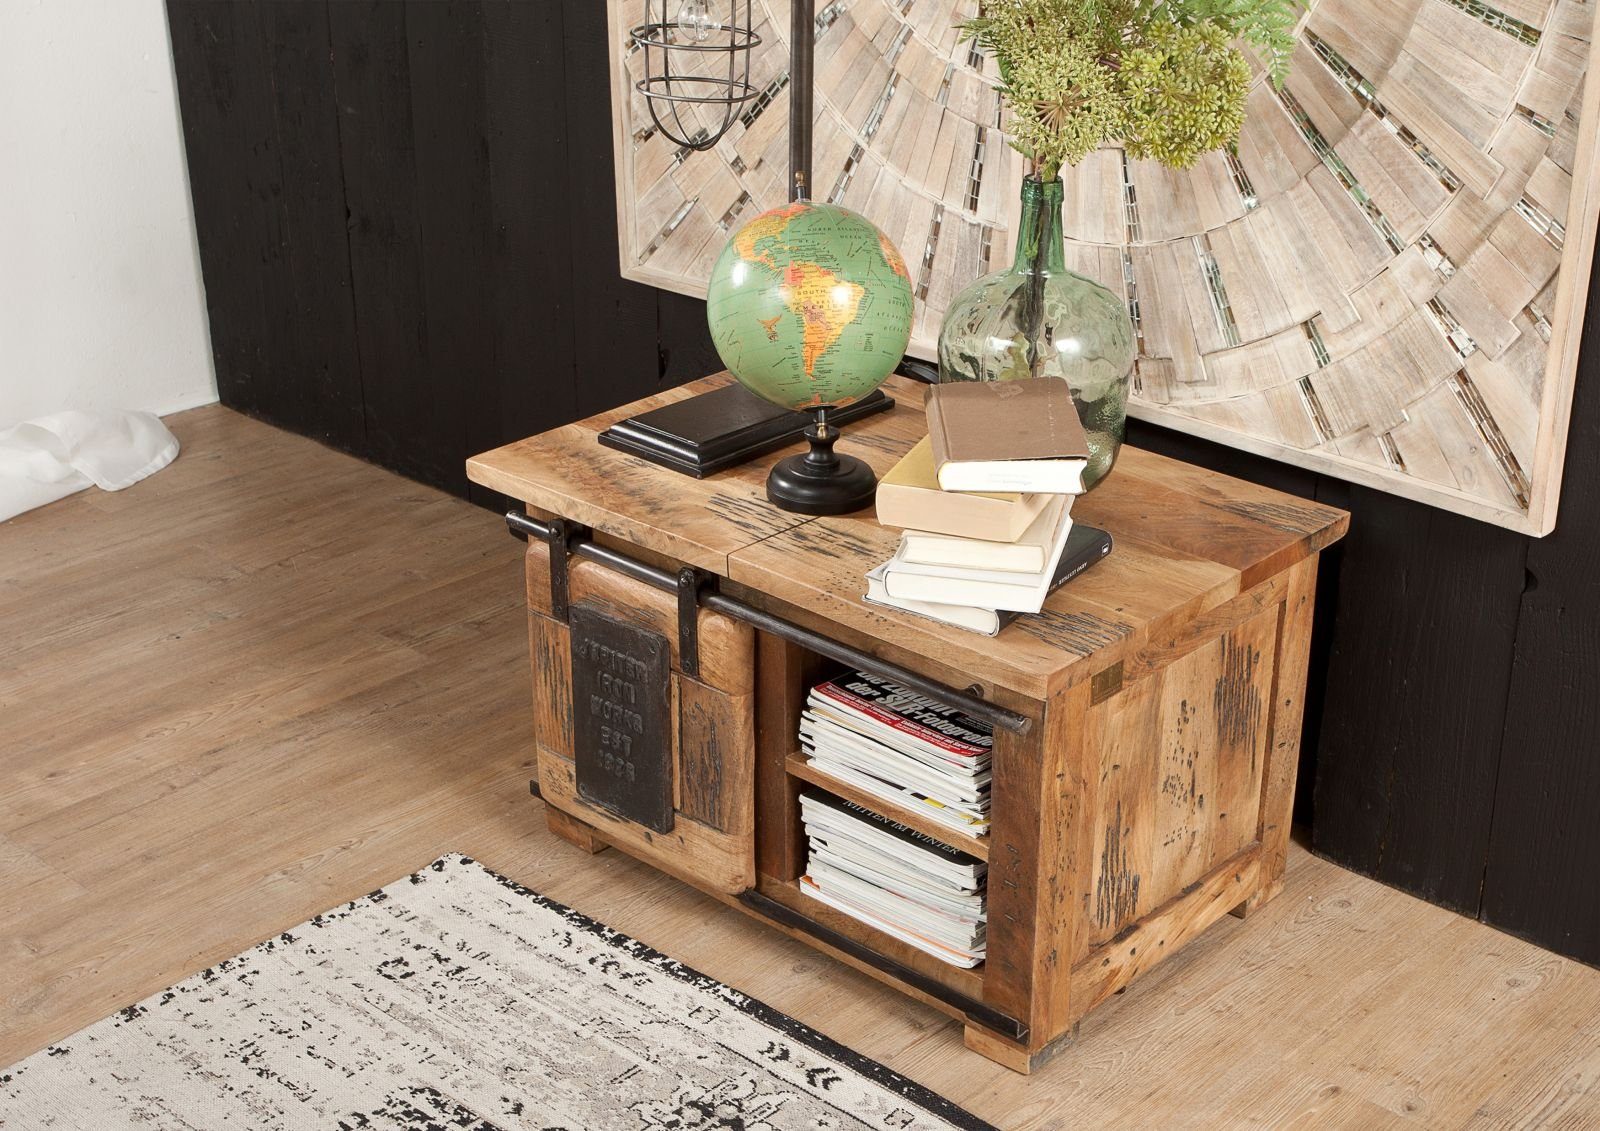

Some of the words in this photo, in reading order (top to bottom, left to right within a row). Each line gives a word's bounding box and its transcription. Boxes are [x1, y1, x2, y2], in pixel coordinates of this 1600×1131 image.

[845, 682, 882, 697] der
[600, 725, 632, 757] EST
[843, 800, 891, 824] MITTEN
[891, 822, 910, 832] IM
[910, 830, 960, 856] WINTER
